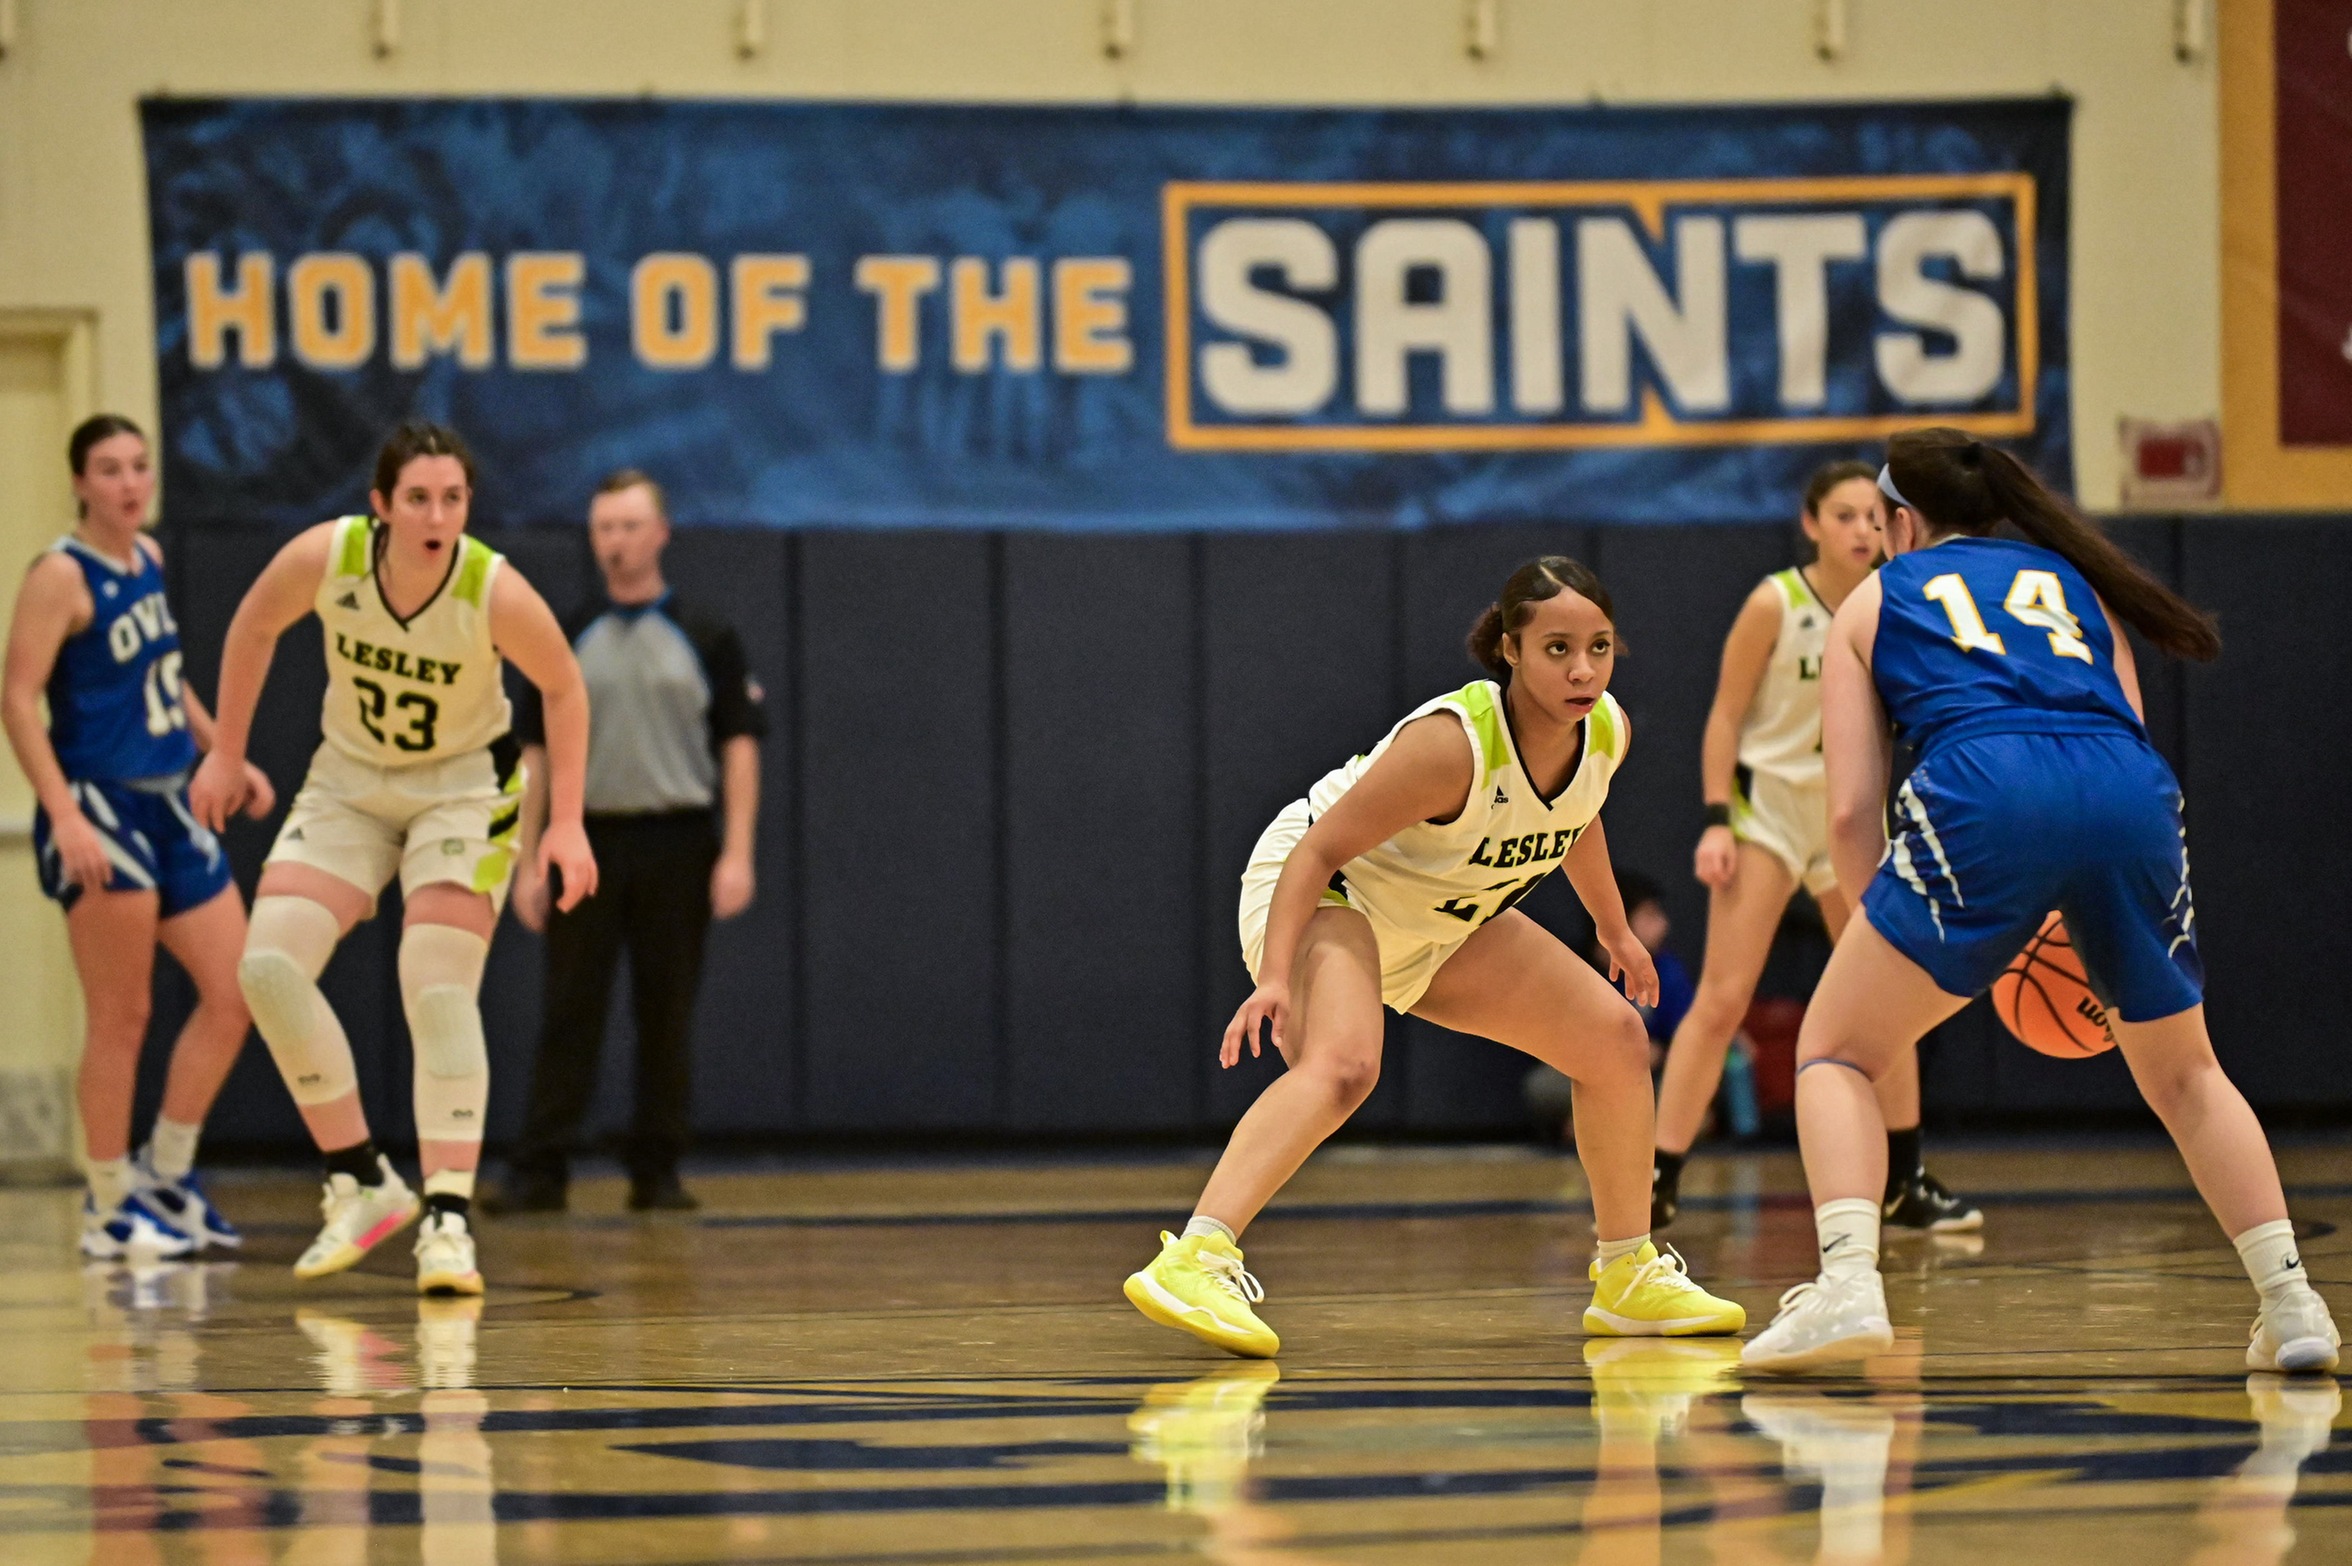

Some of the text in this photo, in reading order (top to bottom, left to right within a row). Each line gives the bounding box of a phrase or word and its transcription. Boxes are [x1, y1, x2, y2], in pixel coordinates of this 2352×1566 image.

[184, 251, 1133, 373] HOME OF THE
[1198, 209, 2006, 417] SAINTS
[335, 631, 462, 687] LESLEY
[1922, 568, 2094, 666] 14
[352, 675, 440, 753] 23
